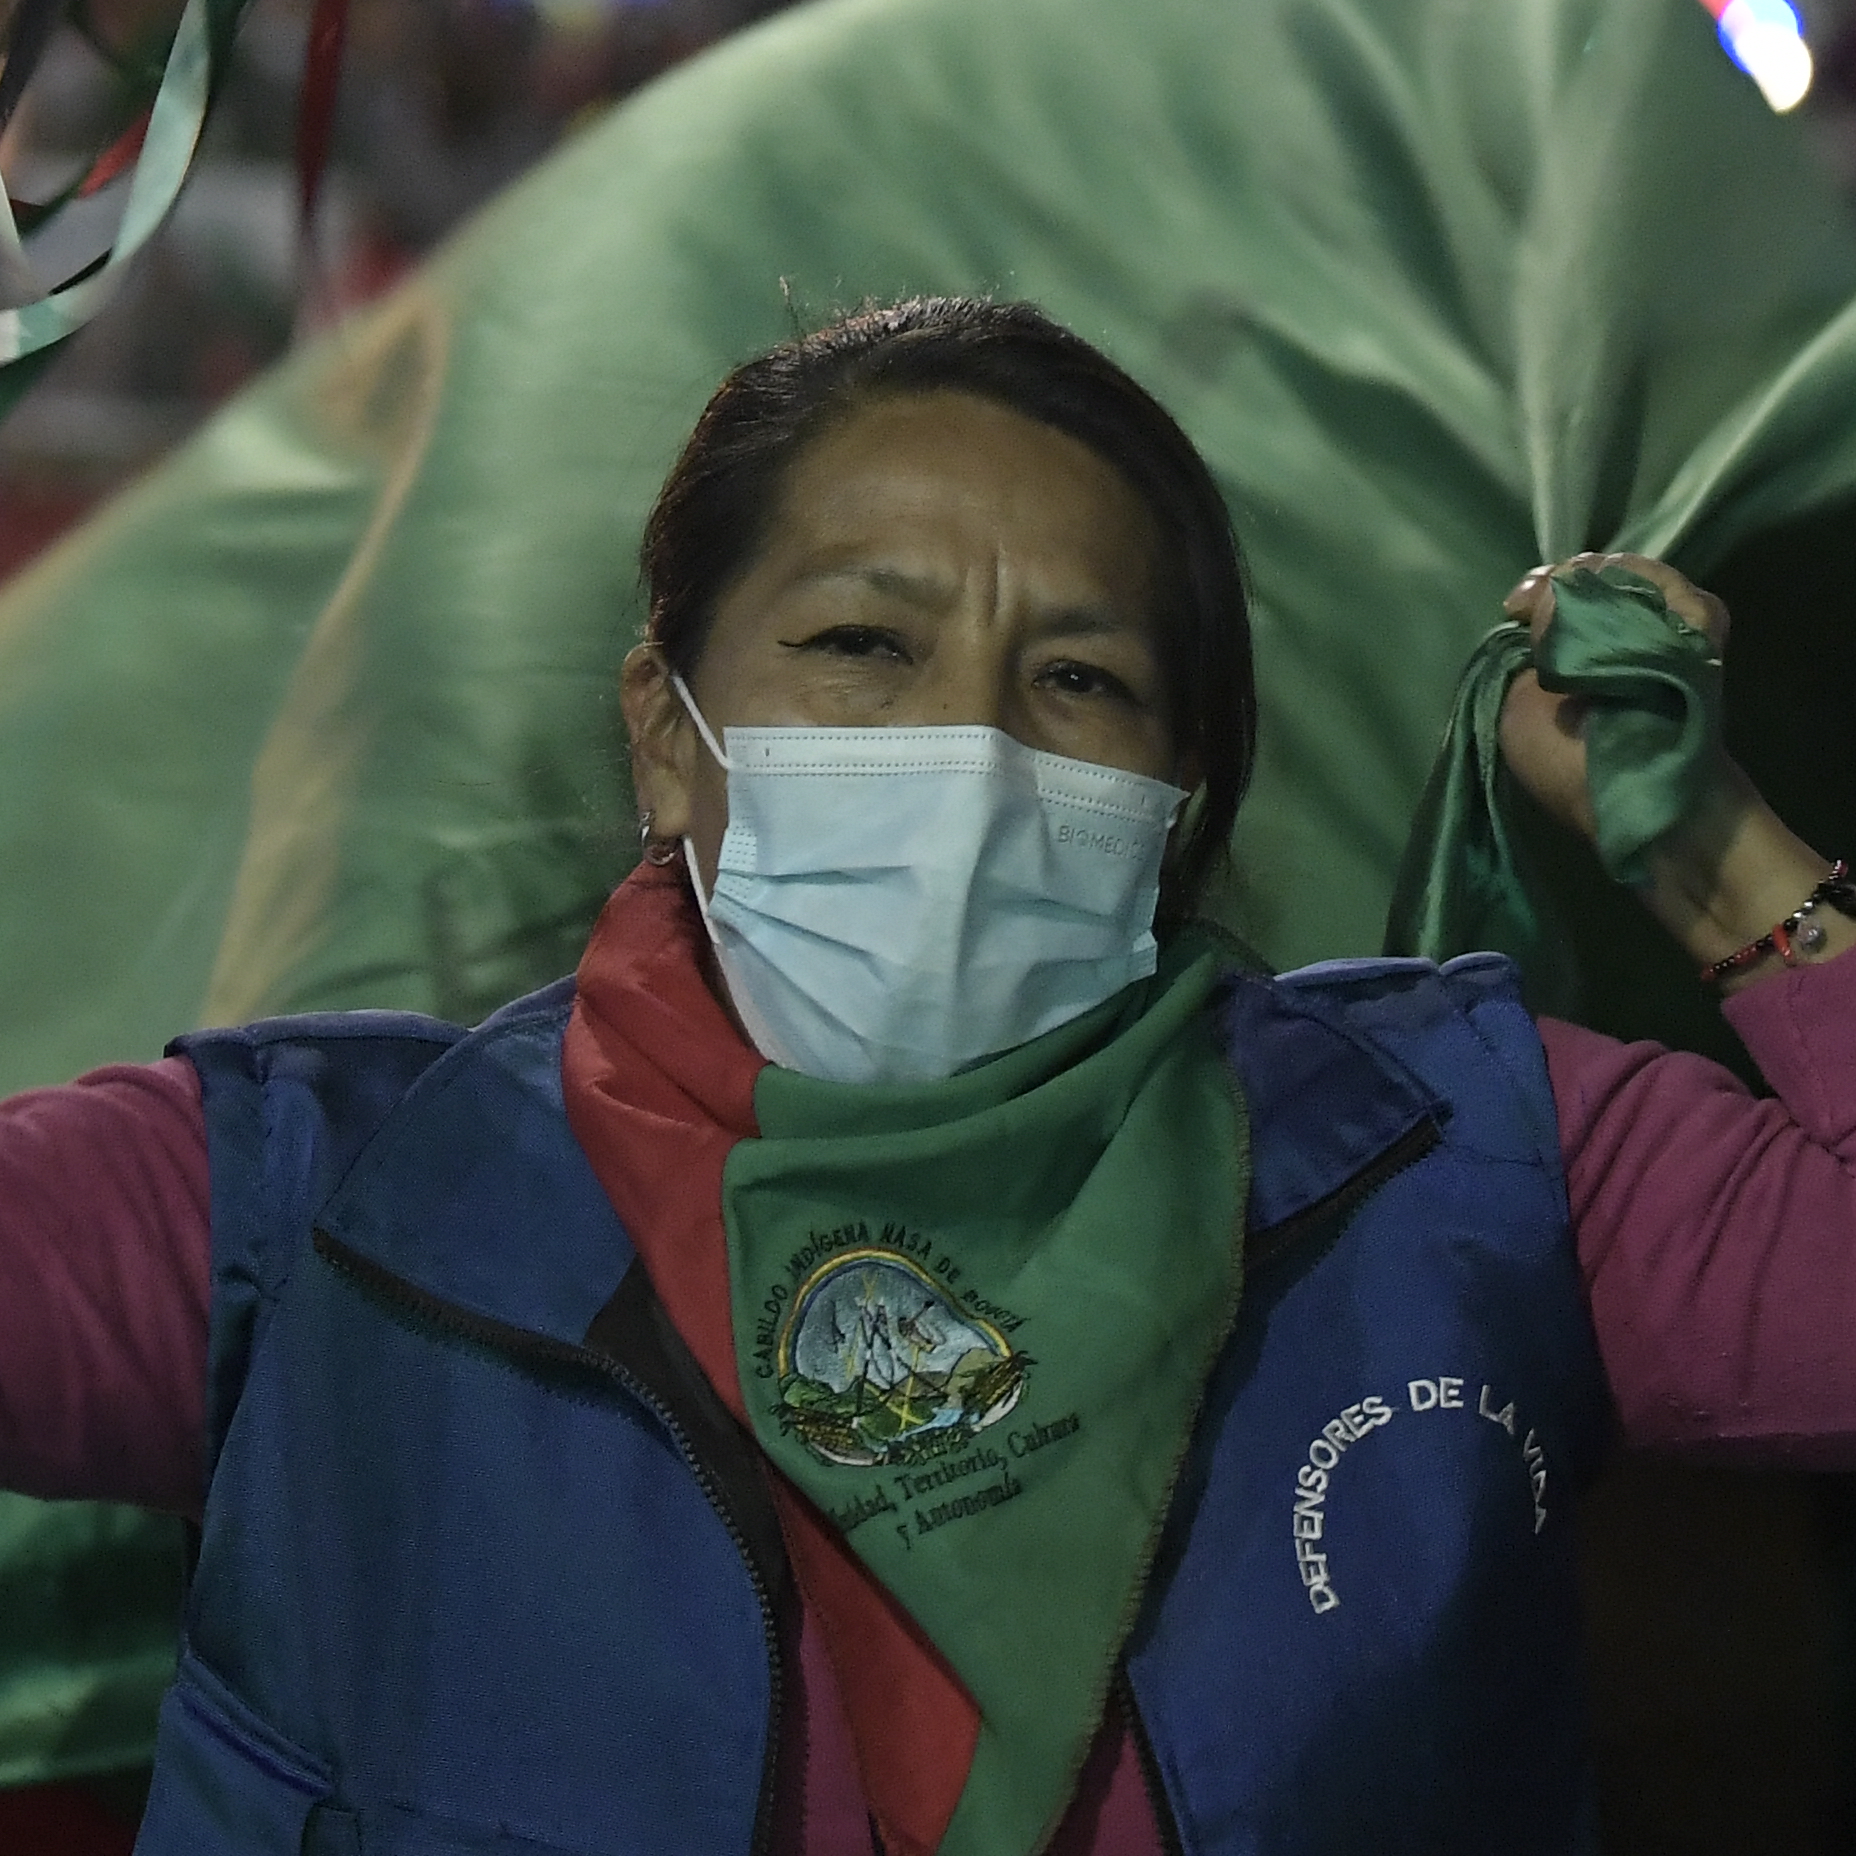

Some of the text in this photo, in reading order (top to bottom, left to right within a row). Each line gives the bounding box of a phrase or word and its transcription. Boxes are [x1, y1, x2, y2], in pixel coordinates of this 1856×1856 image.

[753, 1284, 788, 1378] CABILDO
[880, 1222, 933, 1260] NASA
[934, 1257, 961, 1284] DE
[897, 1524, 911, 1550] y
[1294, 1396, 1393, 1614] DEFENSORES
[1408, 1376, 1464, 1412] DE
[1479, 1384, 1515, 1435] LA
